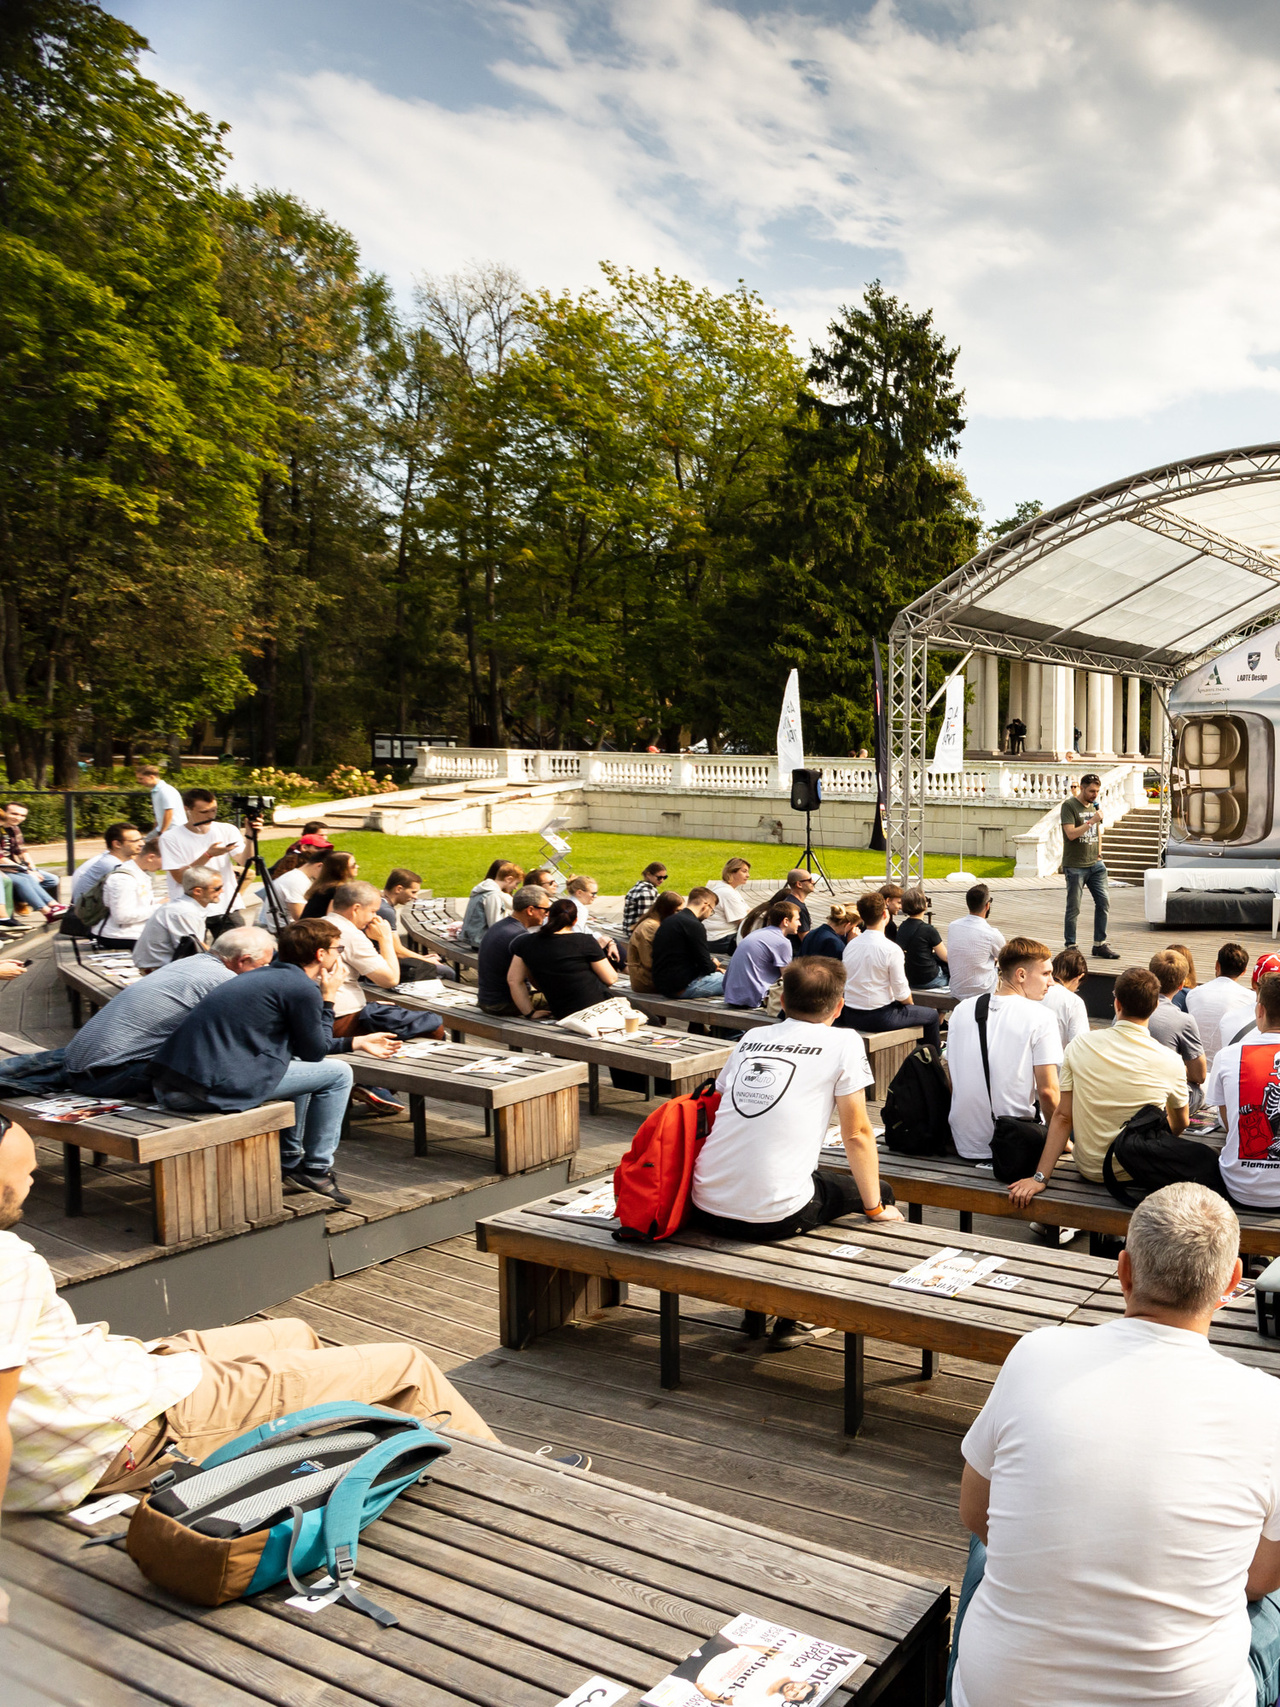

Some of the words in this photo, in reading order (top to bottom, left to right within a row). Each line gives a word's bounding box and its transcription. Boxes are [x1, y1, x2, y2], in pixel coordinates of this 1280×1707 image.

[1252, 673, 1268, 682] Design
[736, 1091, 774, 1100] INNOVATIONS
[994, 1276, 1019, 1286] 28
[790, 1641, 824, 1668] КРИСА
[813, 1643, 835, 1662] ГОД
